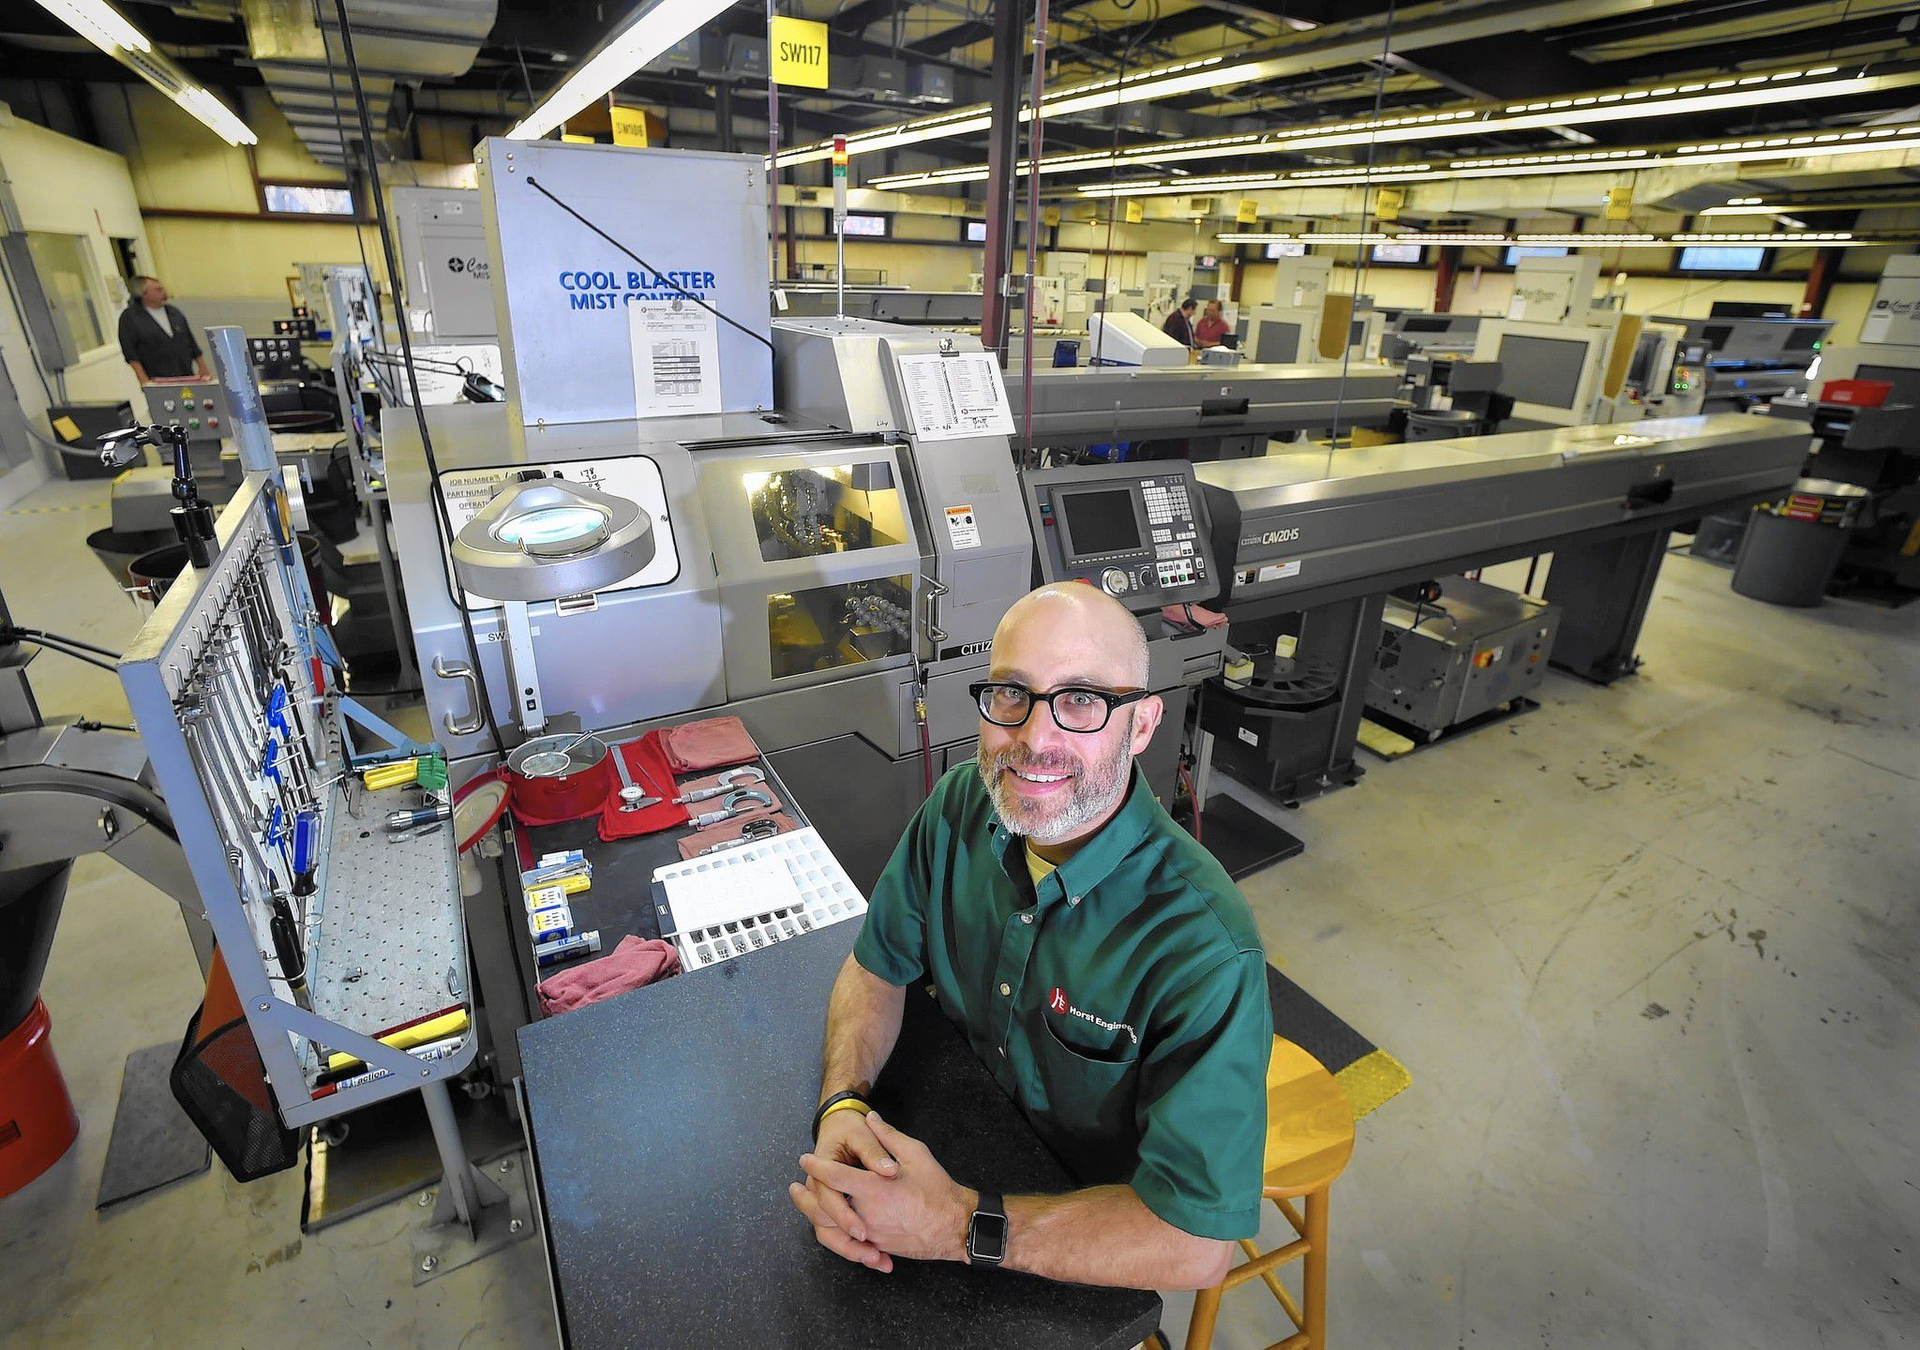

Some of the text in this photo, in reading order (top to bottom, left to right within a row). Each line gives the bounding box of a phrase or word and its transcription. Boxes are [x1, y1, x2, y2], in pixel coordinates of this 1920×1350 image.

[780, 41, 822, 66] SW117
[559, 271, 716, 290] COOL BLASTER
[570, 293, 618, 310] MIST
[450, 475, 494, 486] JOB NUMBER
[446, 490, 464, 498] PART
[1069, 1005, 1095, 1023] Horst
